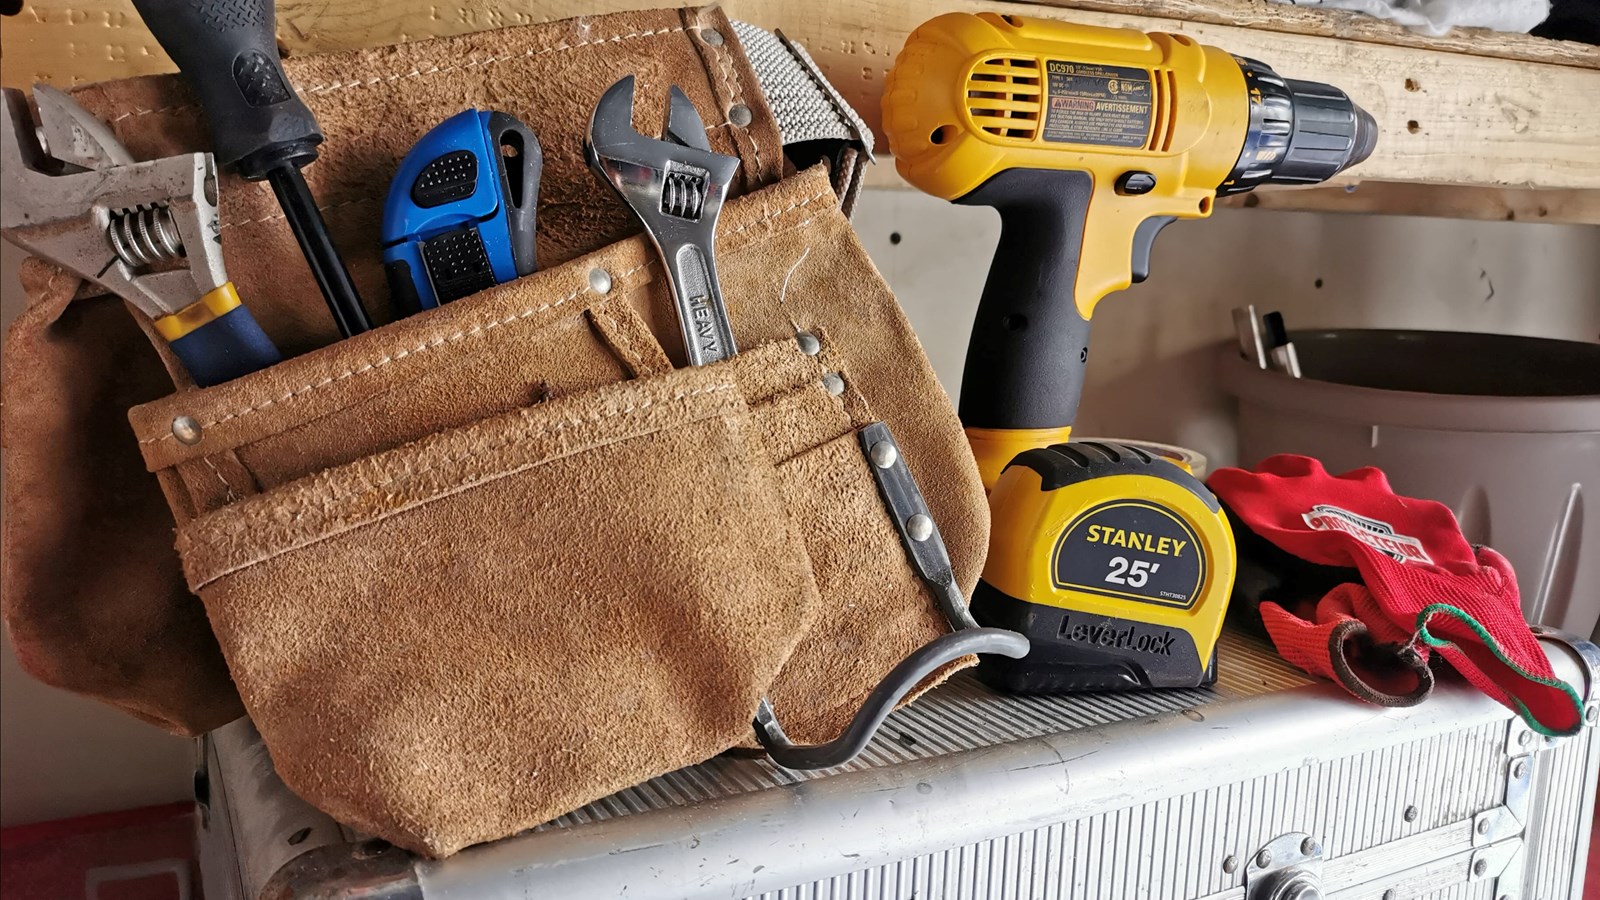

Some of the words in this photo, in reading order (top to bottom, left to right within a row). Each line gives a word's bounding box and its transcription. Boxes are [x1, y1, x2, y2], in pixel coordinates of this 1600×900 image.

[1049, 63, 1074, 74] DC970
[1061, 99, 1094, 110] WARNING
[1250, 87, 1262, 105] 17
[1096, 102, 1148, 114] AVERTISSEMENT
[689, 294, 718, 352] HEAVY
[1086, 524, 1187, 558] STANLEY
[1057, 614, 1177, 656] LeverLock
